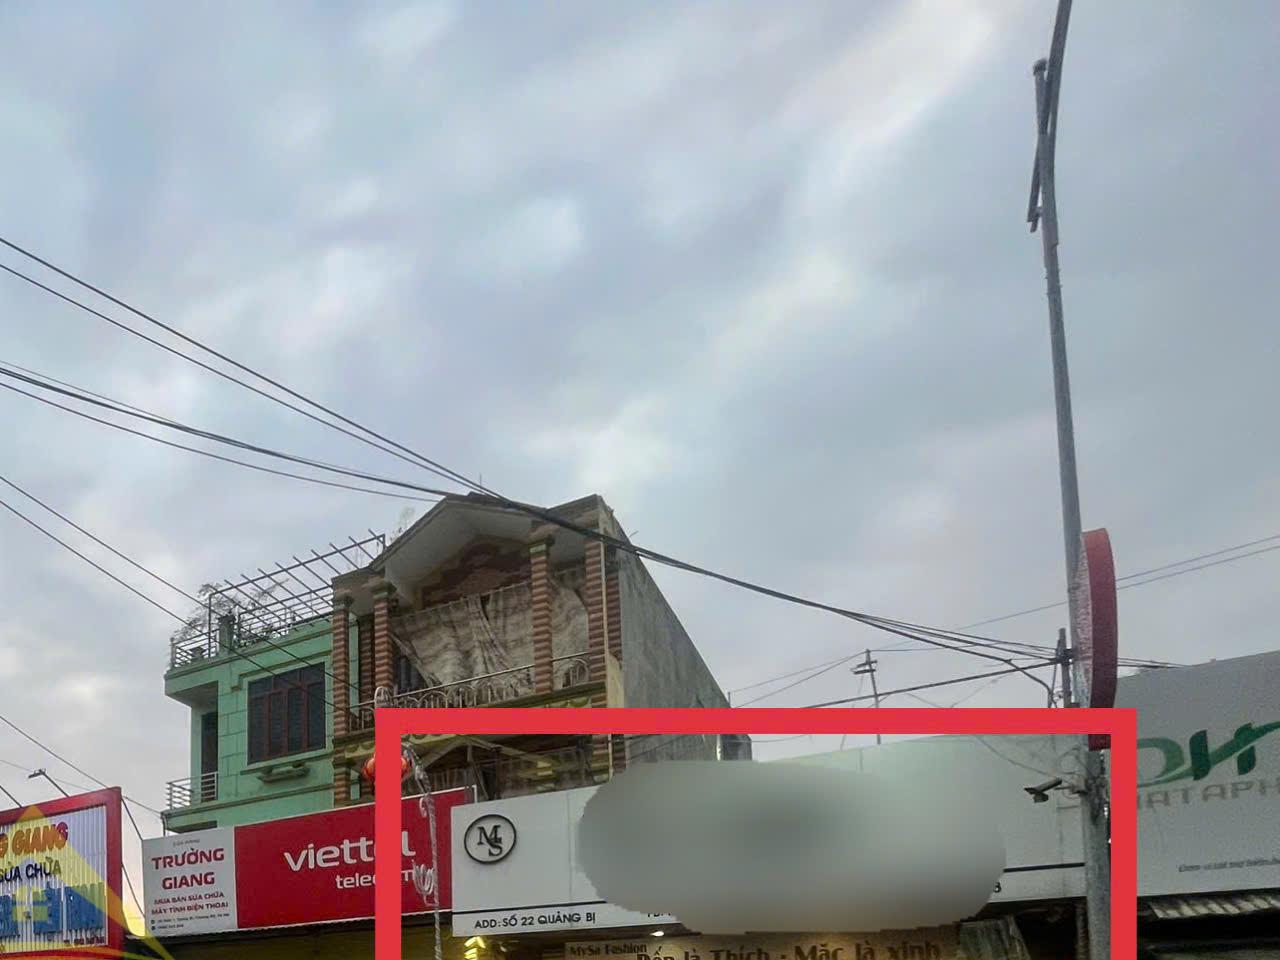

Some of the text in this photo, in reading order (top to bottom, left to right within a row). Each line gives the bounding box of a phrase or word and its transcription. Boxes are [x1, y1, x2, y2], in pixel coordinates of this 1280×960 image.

[12, 822, 68, 855] GIANG
[152, 847, 224, 870] TRƯỜNG
[284, 831, 417, 871] viettl
[25, 856, 61, 879] CHỮA
[162, 872, 215, 890] GIANG
[521, 916, 535, 926] 22
[537, 911, 581, 924] QUẢNG
